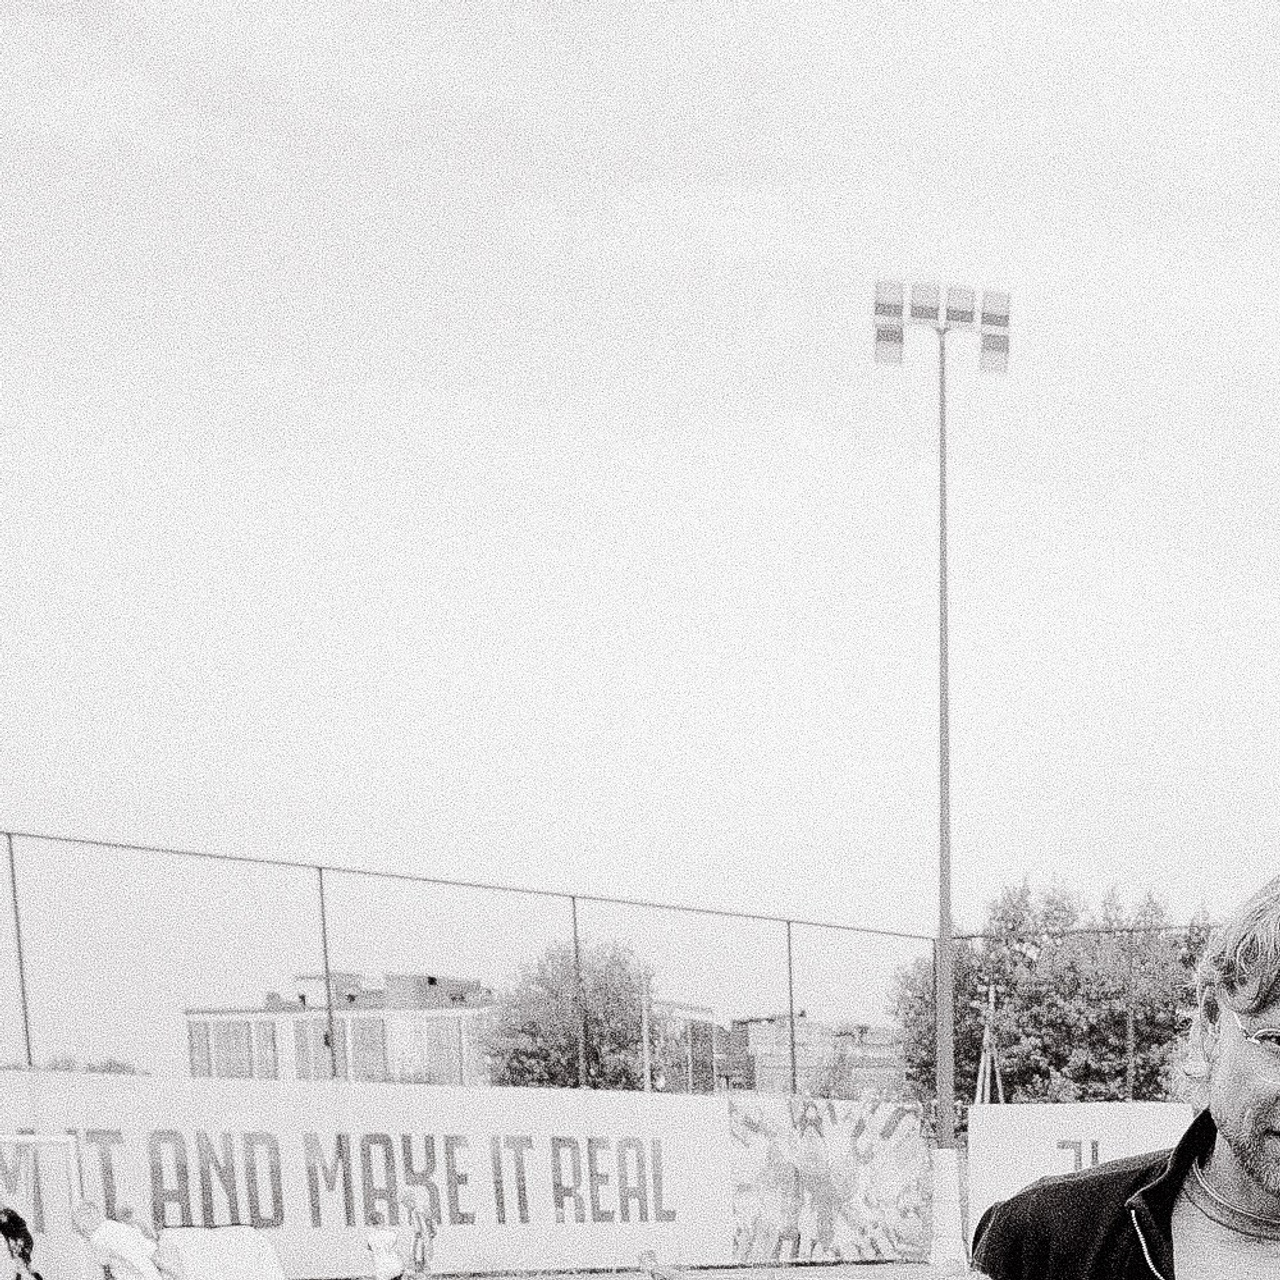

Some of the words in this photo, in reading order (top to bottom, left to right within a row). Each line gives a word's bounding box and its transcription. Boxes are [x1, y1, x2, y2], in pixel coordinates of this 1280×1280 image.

[151, 1129, 285, 1228] AND
[303, 1132, 477, 1229] MAKE
[490, 1134, 535, 1225] IT
[550, 1136, 678, 1225] REAL
